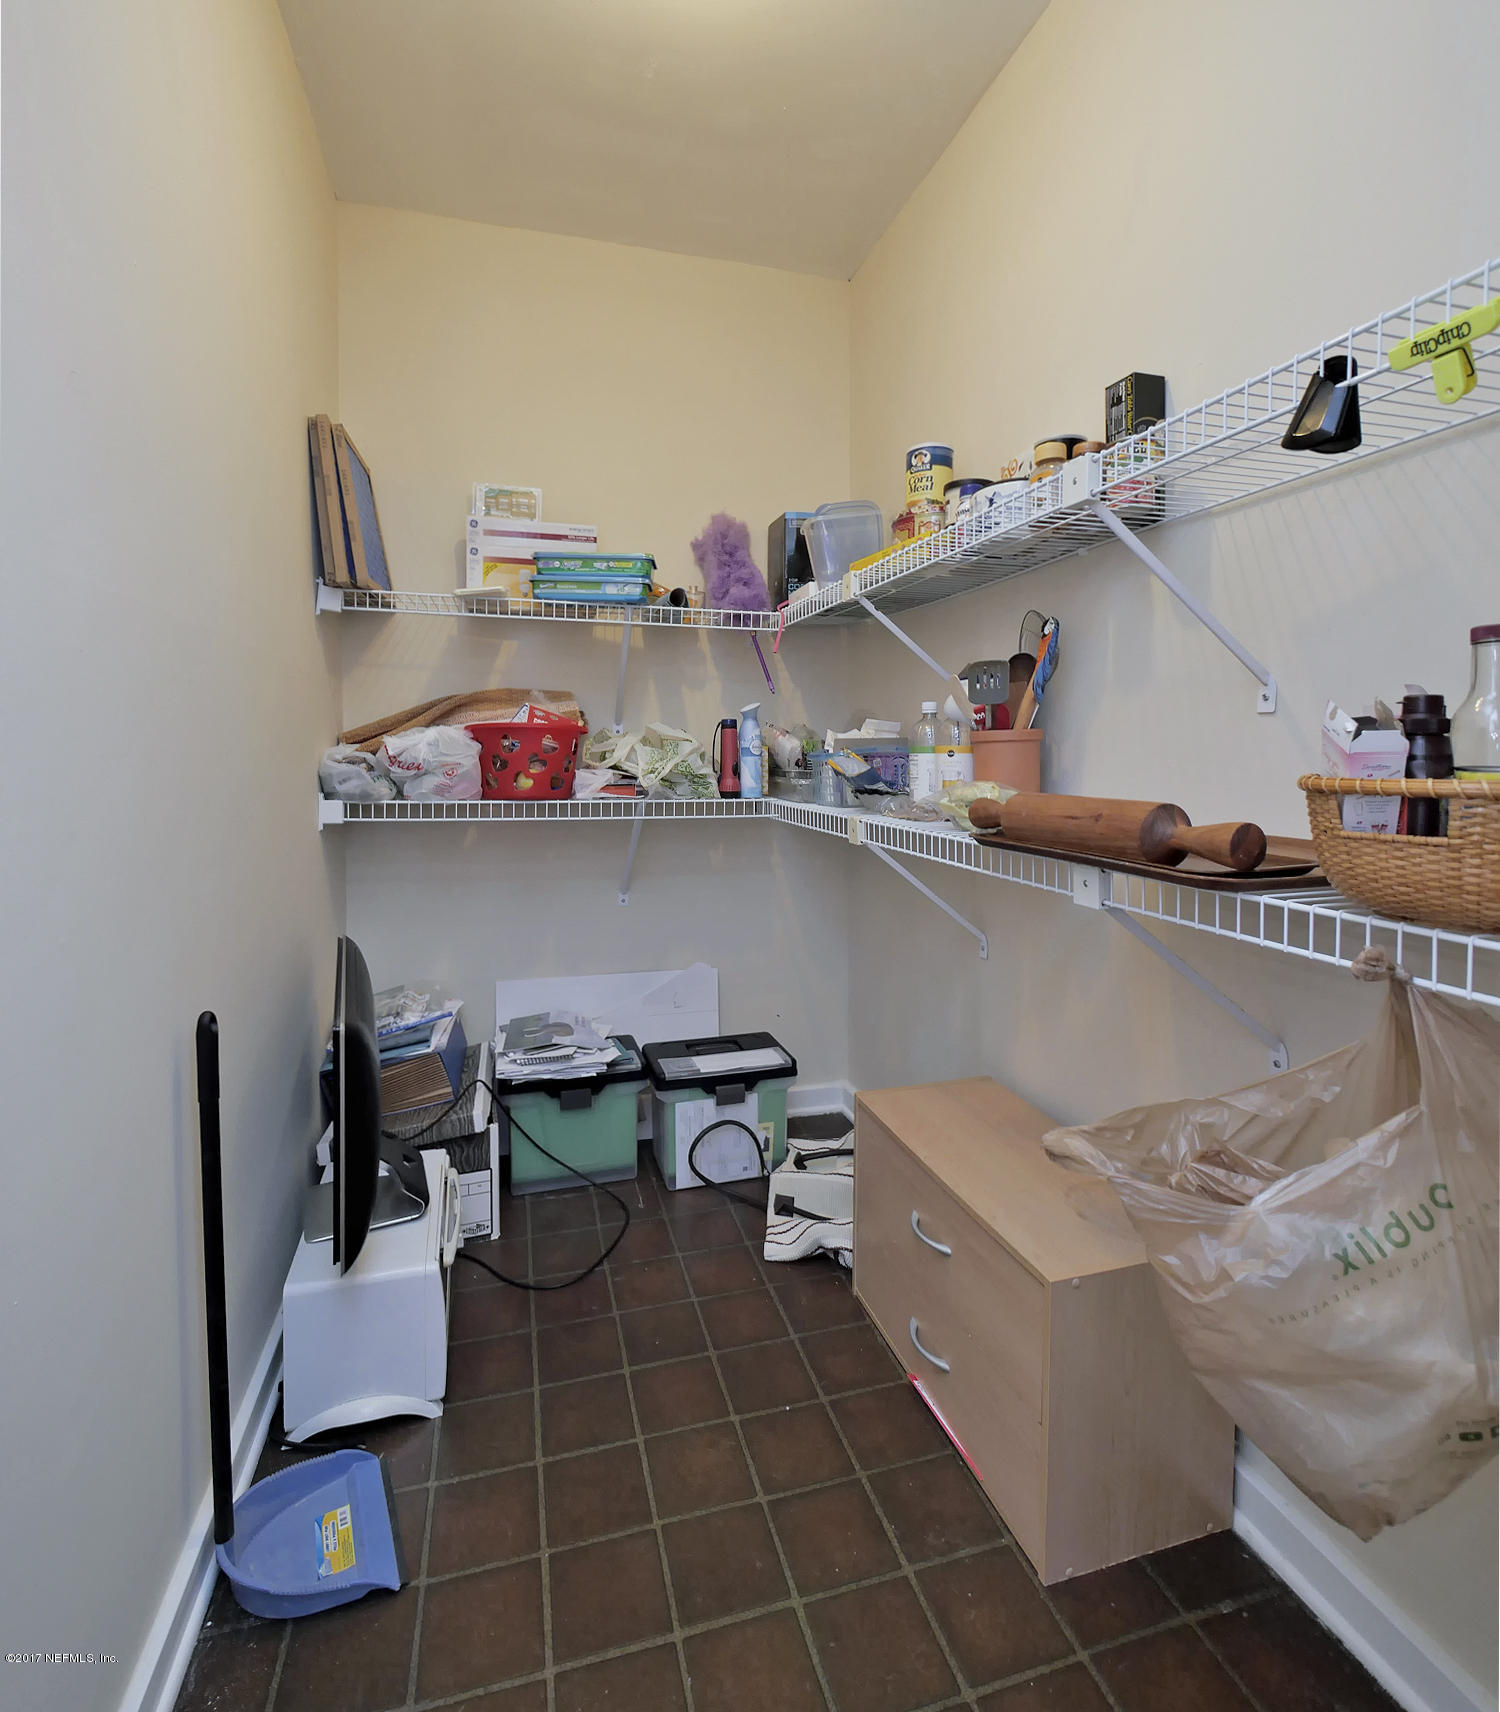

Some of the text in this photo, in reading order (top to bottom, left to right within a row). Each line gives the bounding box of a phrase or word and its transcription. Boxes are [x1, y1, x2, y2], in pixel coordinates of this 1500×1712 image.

[1410, 321, 1472, 358] ChipClip
[908, 475, 934, 487] Corn
[908, 481, 934, 494] Meal
